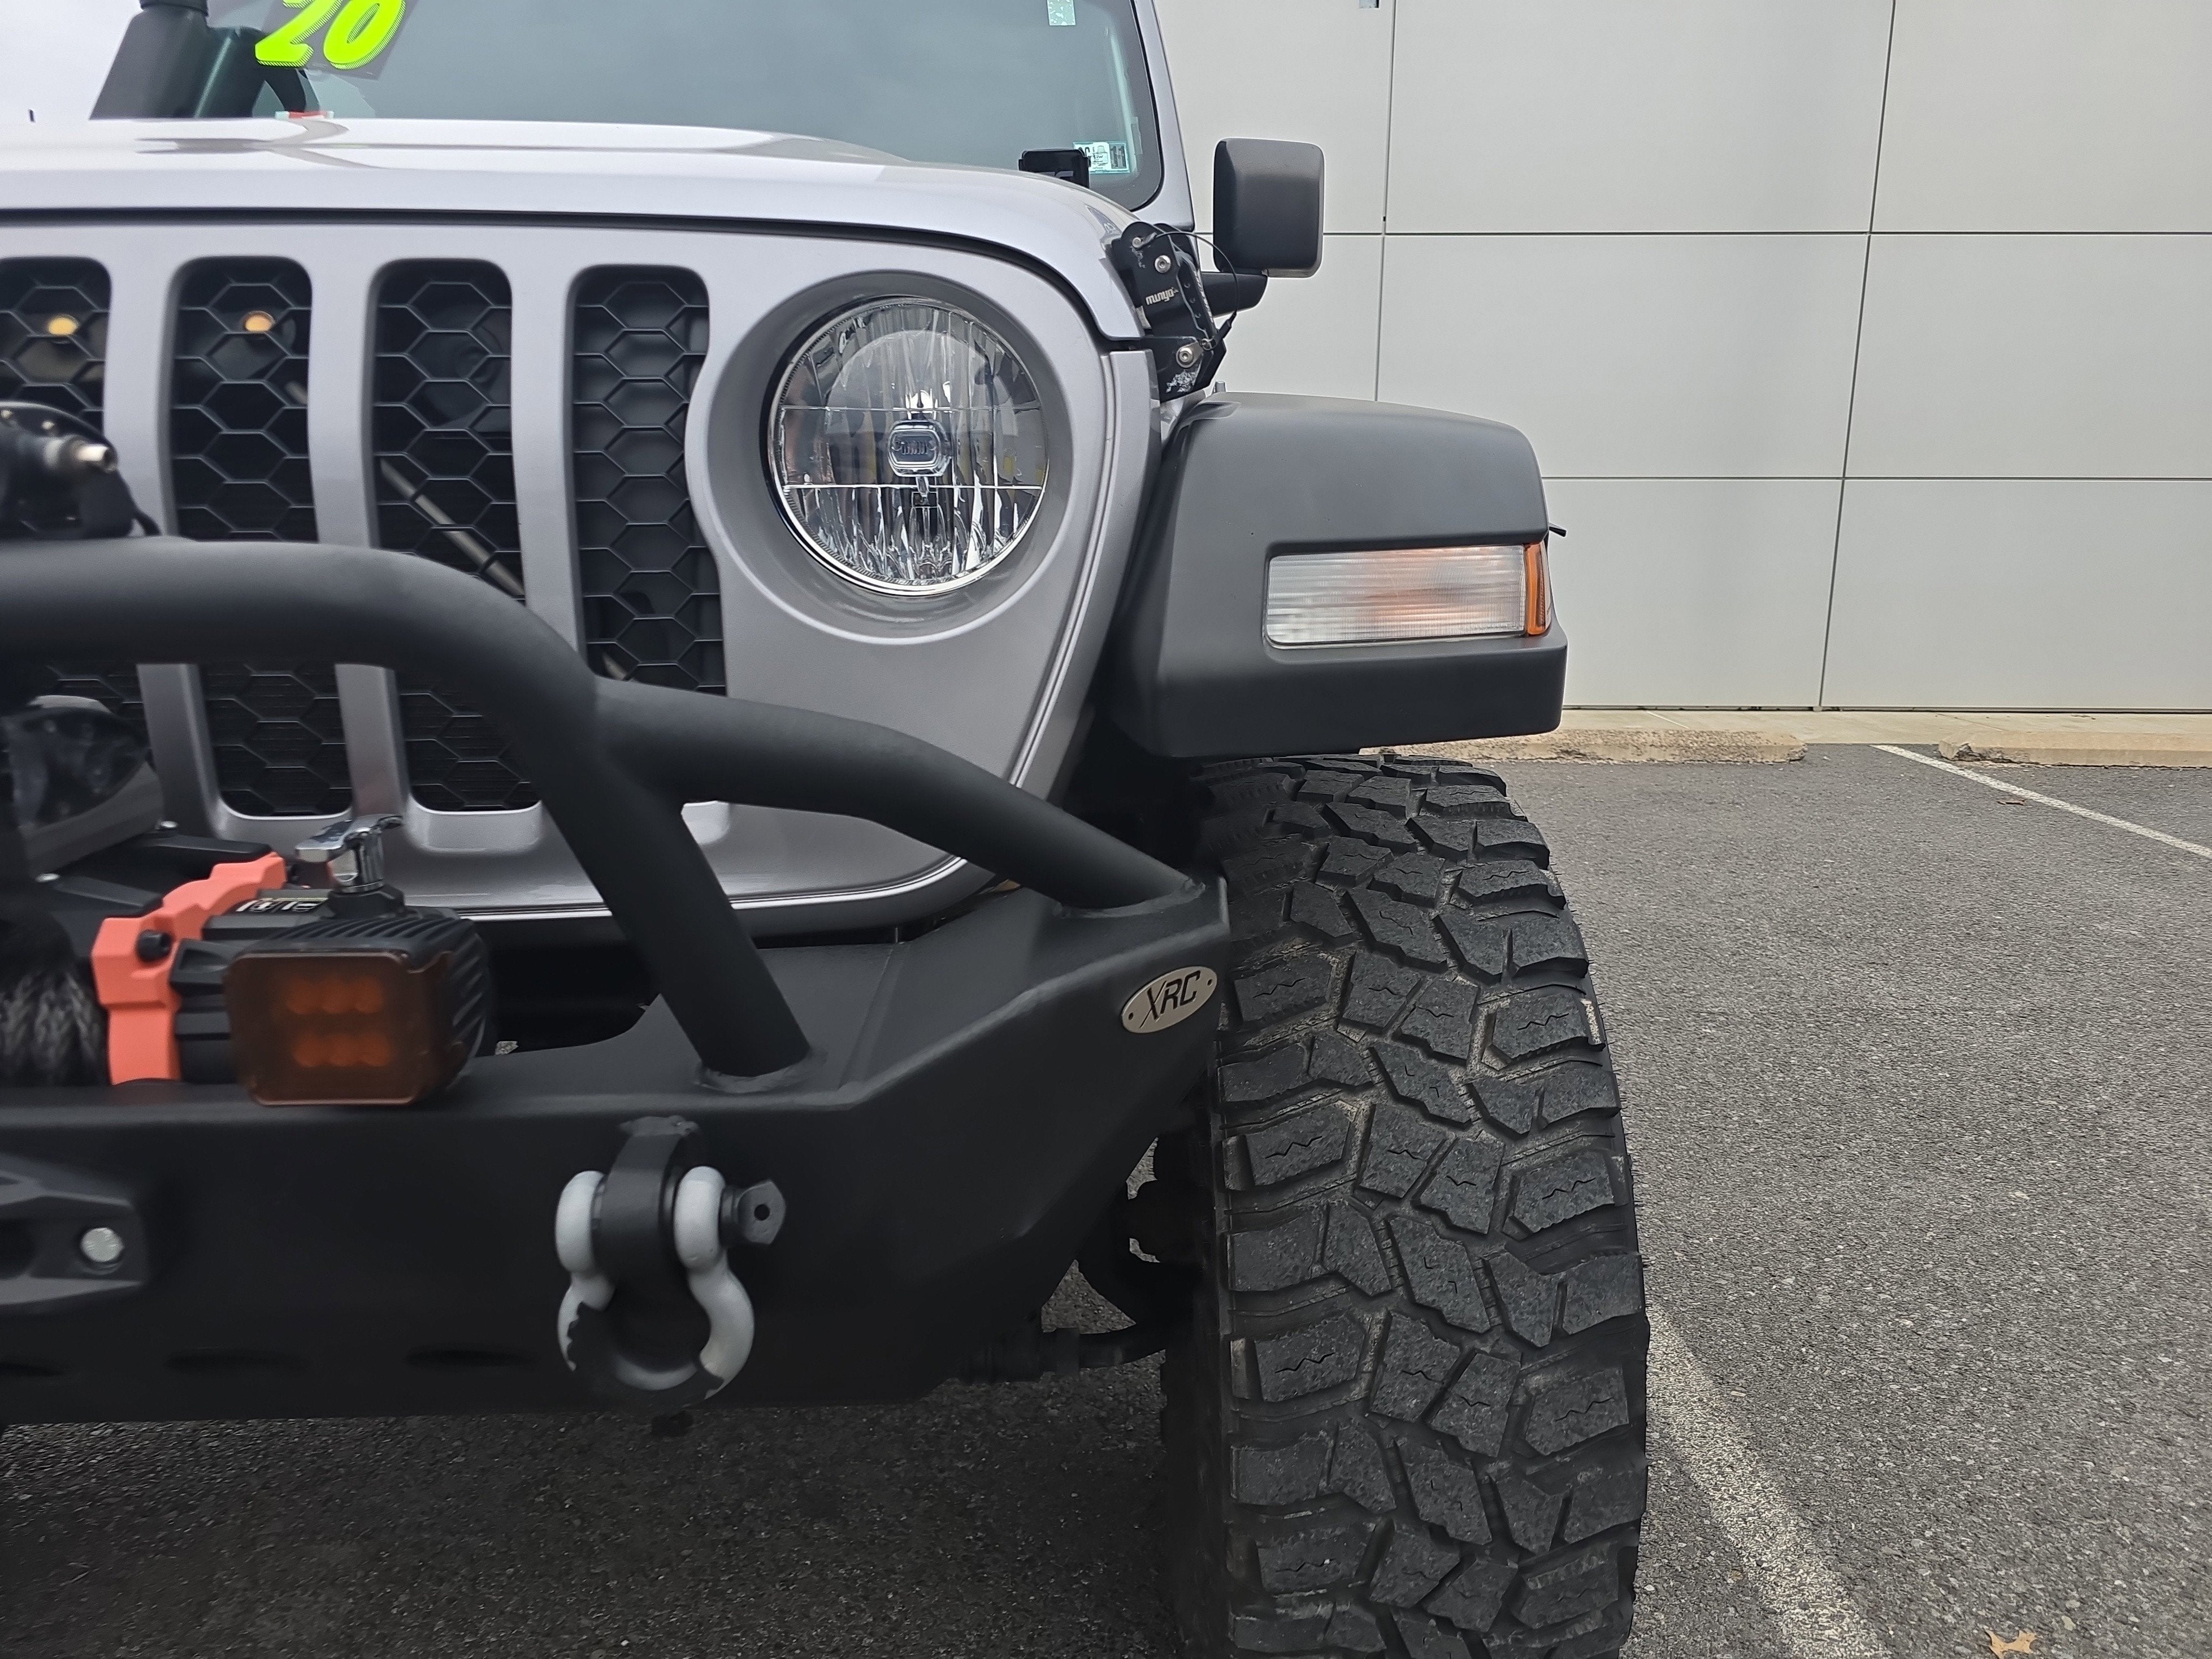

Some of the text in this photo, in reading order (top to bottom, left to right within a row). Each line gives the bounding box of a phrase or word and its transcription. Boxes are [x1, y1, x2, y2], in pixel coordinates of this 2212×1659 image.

[255, 0, 406, 70] 20
[1110, 145, 1127, 168] 11
[1139, 970, 1201, 1029] XRC
